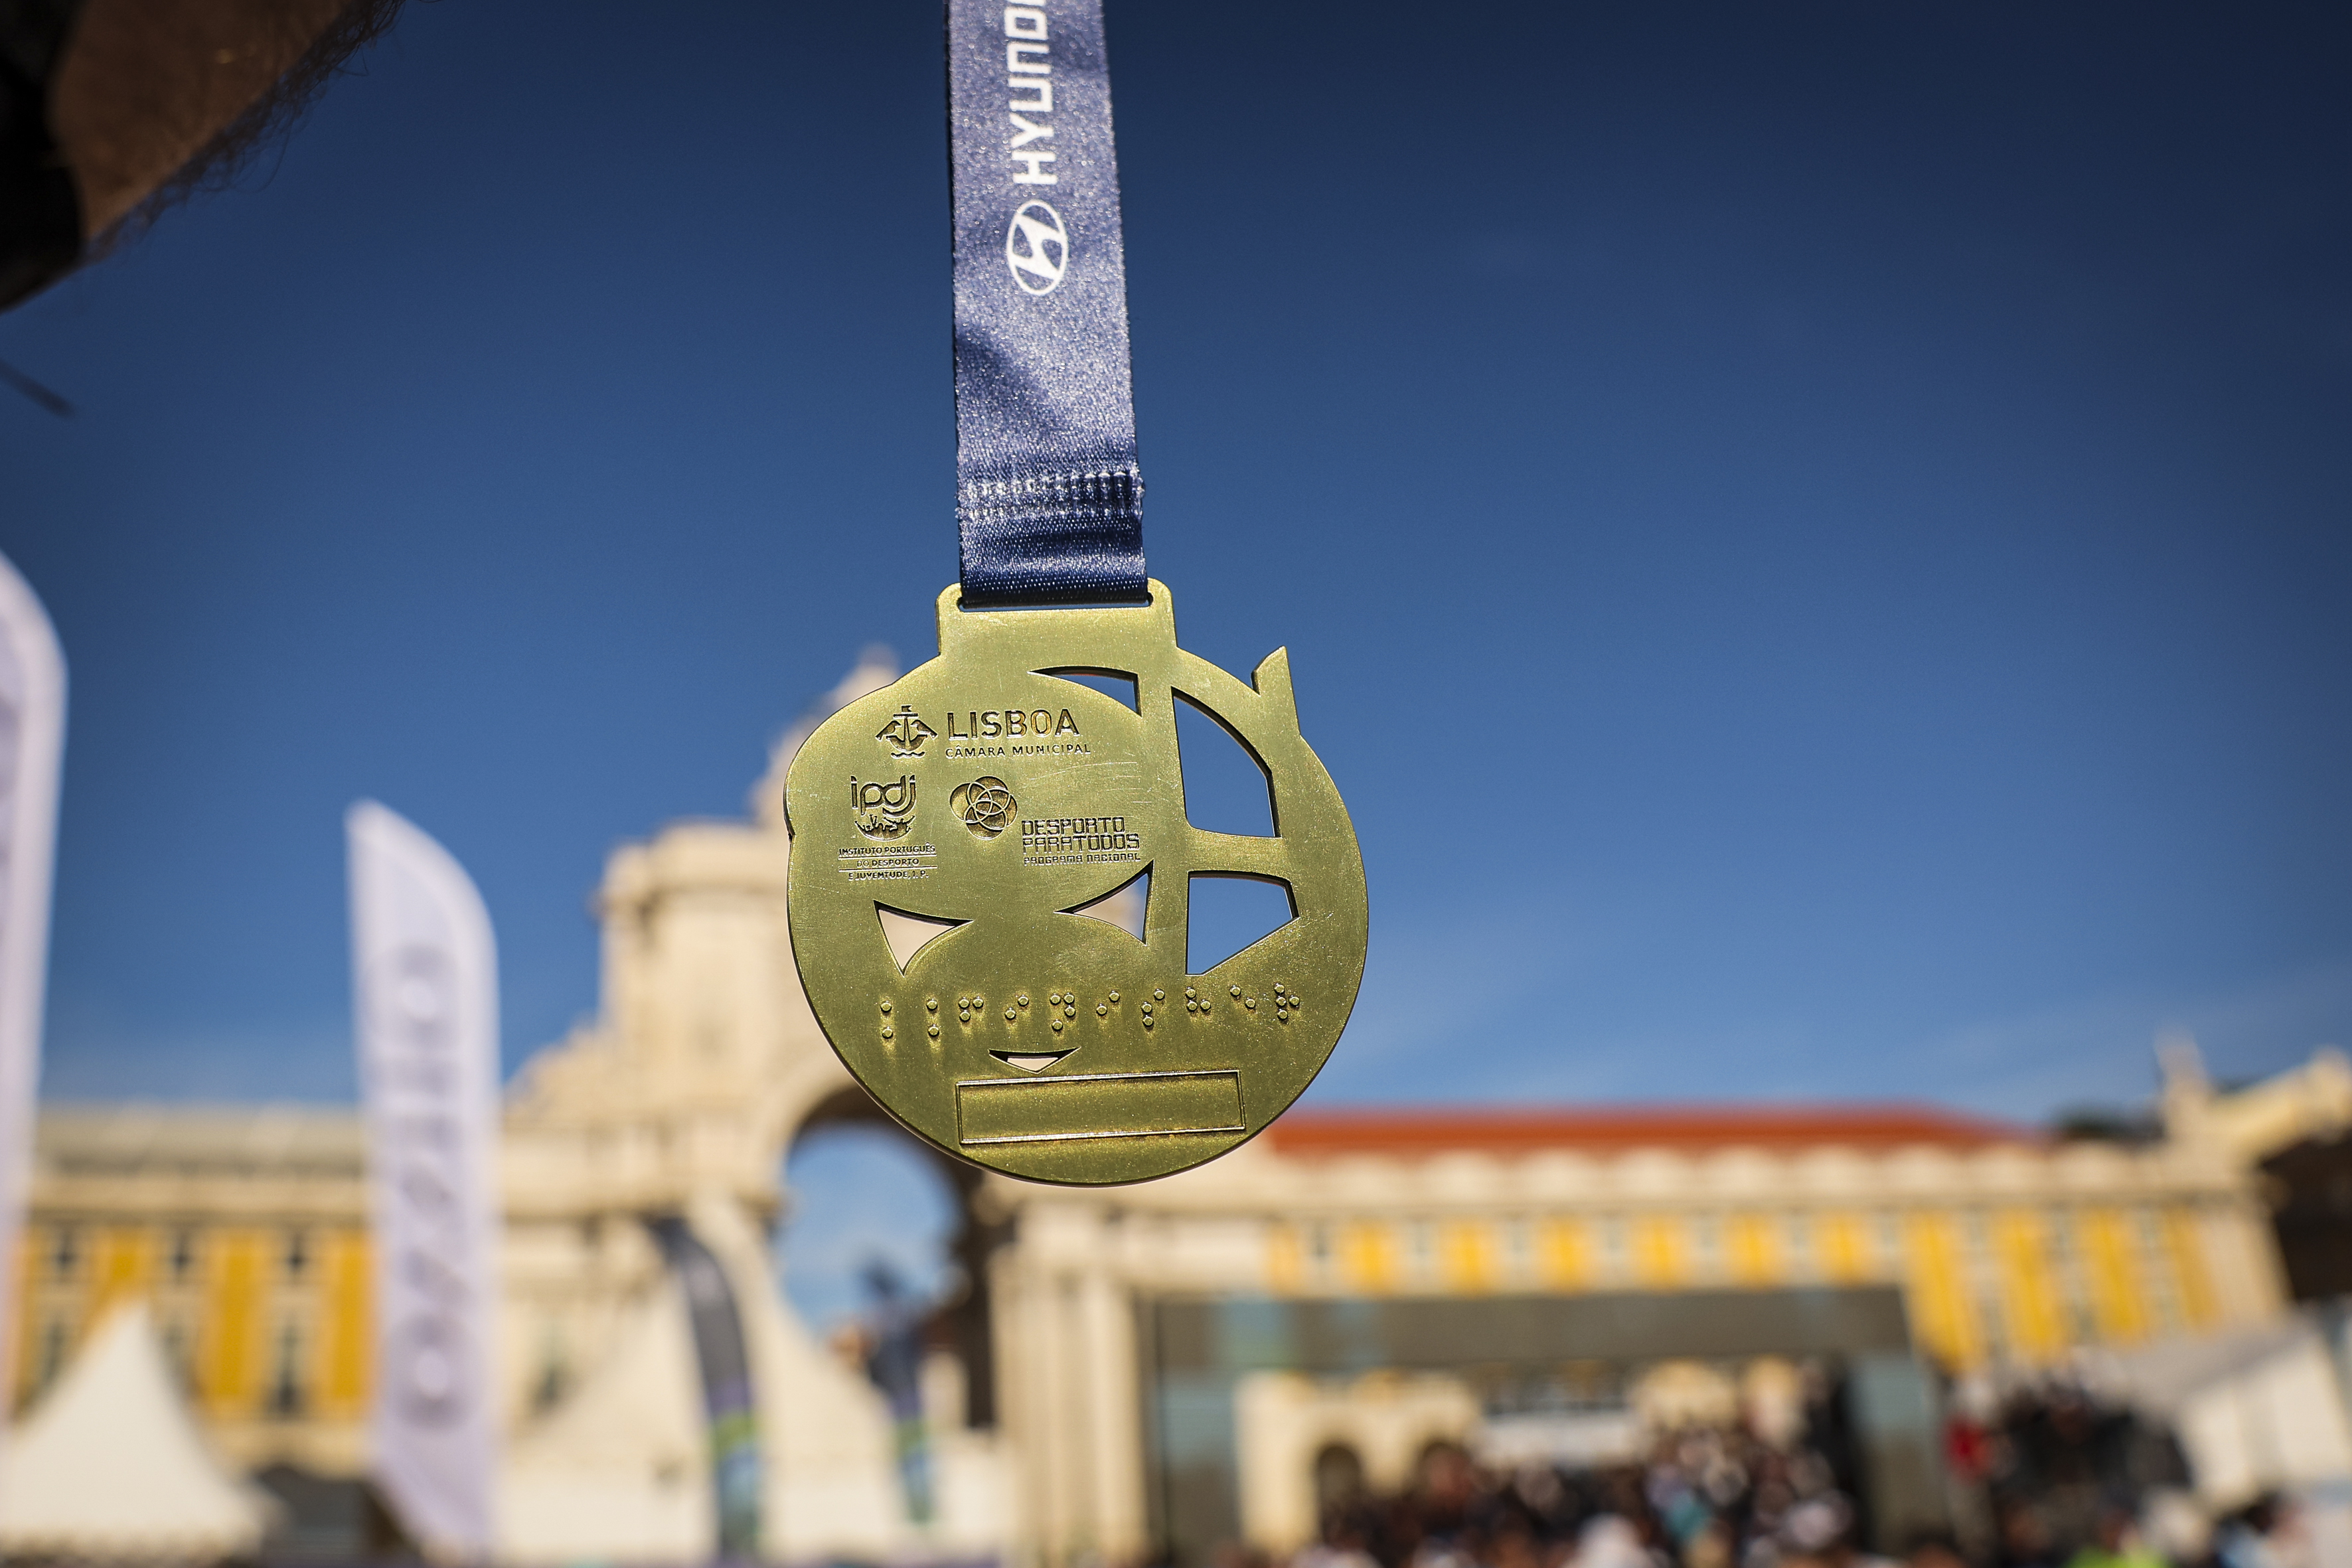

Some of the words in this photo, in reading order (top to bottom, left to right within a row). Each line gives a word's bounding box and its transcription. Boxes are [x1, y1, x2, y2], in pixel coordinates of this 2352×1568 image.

[1004, 0, 1058, 185] HYUND
[947, 708, 1080, 741] LISBOA
[945, 745, 1006, 759] CÂMARA
[1011, 744, 1091, 757] MUNICIPAL
[1022, 817, 1125, 836] DESPORTO
[838, 847, 882, 856] INSTITUTO
[884, 842, 935, 854] PORTUGUÊS
[1022, 833, 1140, 854] PARATODOS
[1024, 854, 1083, 866] PROGRAMA
[1086, 853, 1141, 864] NACIONAL
